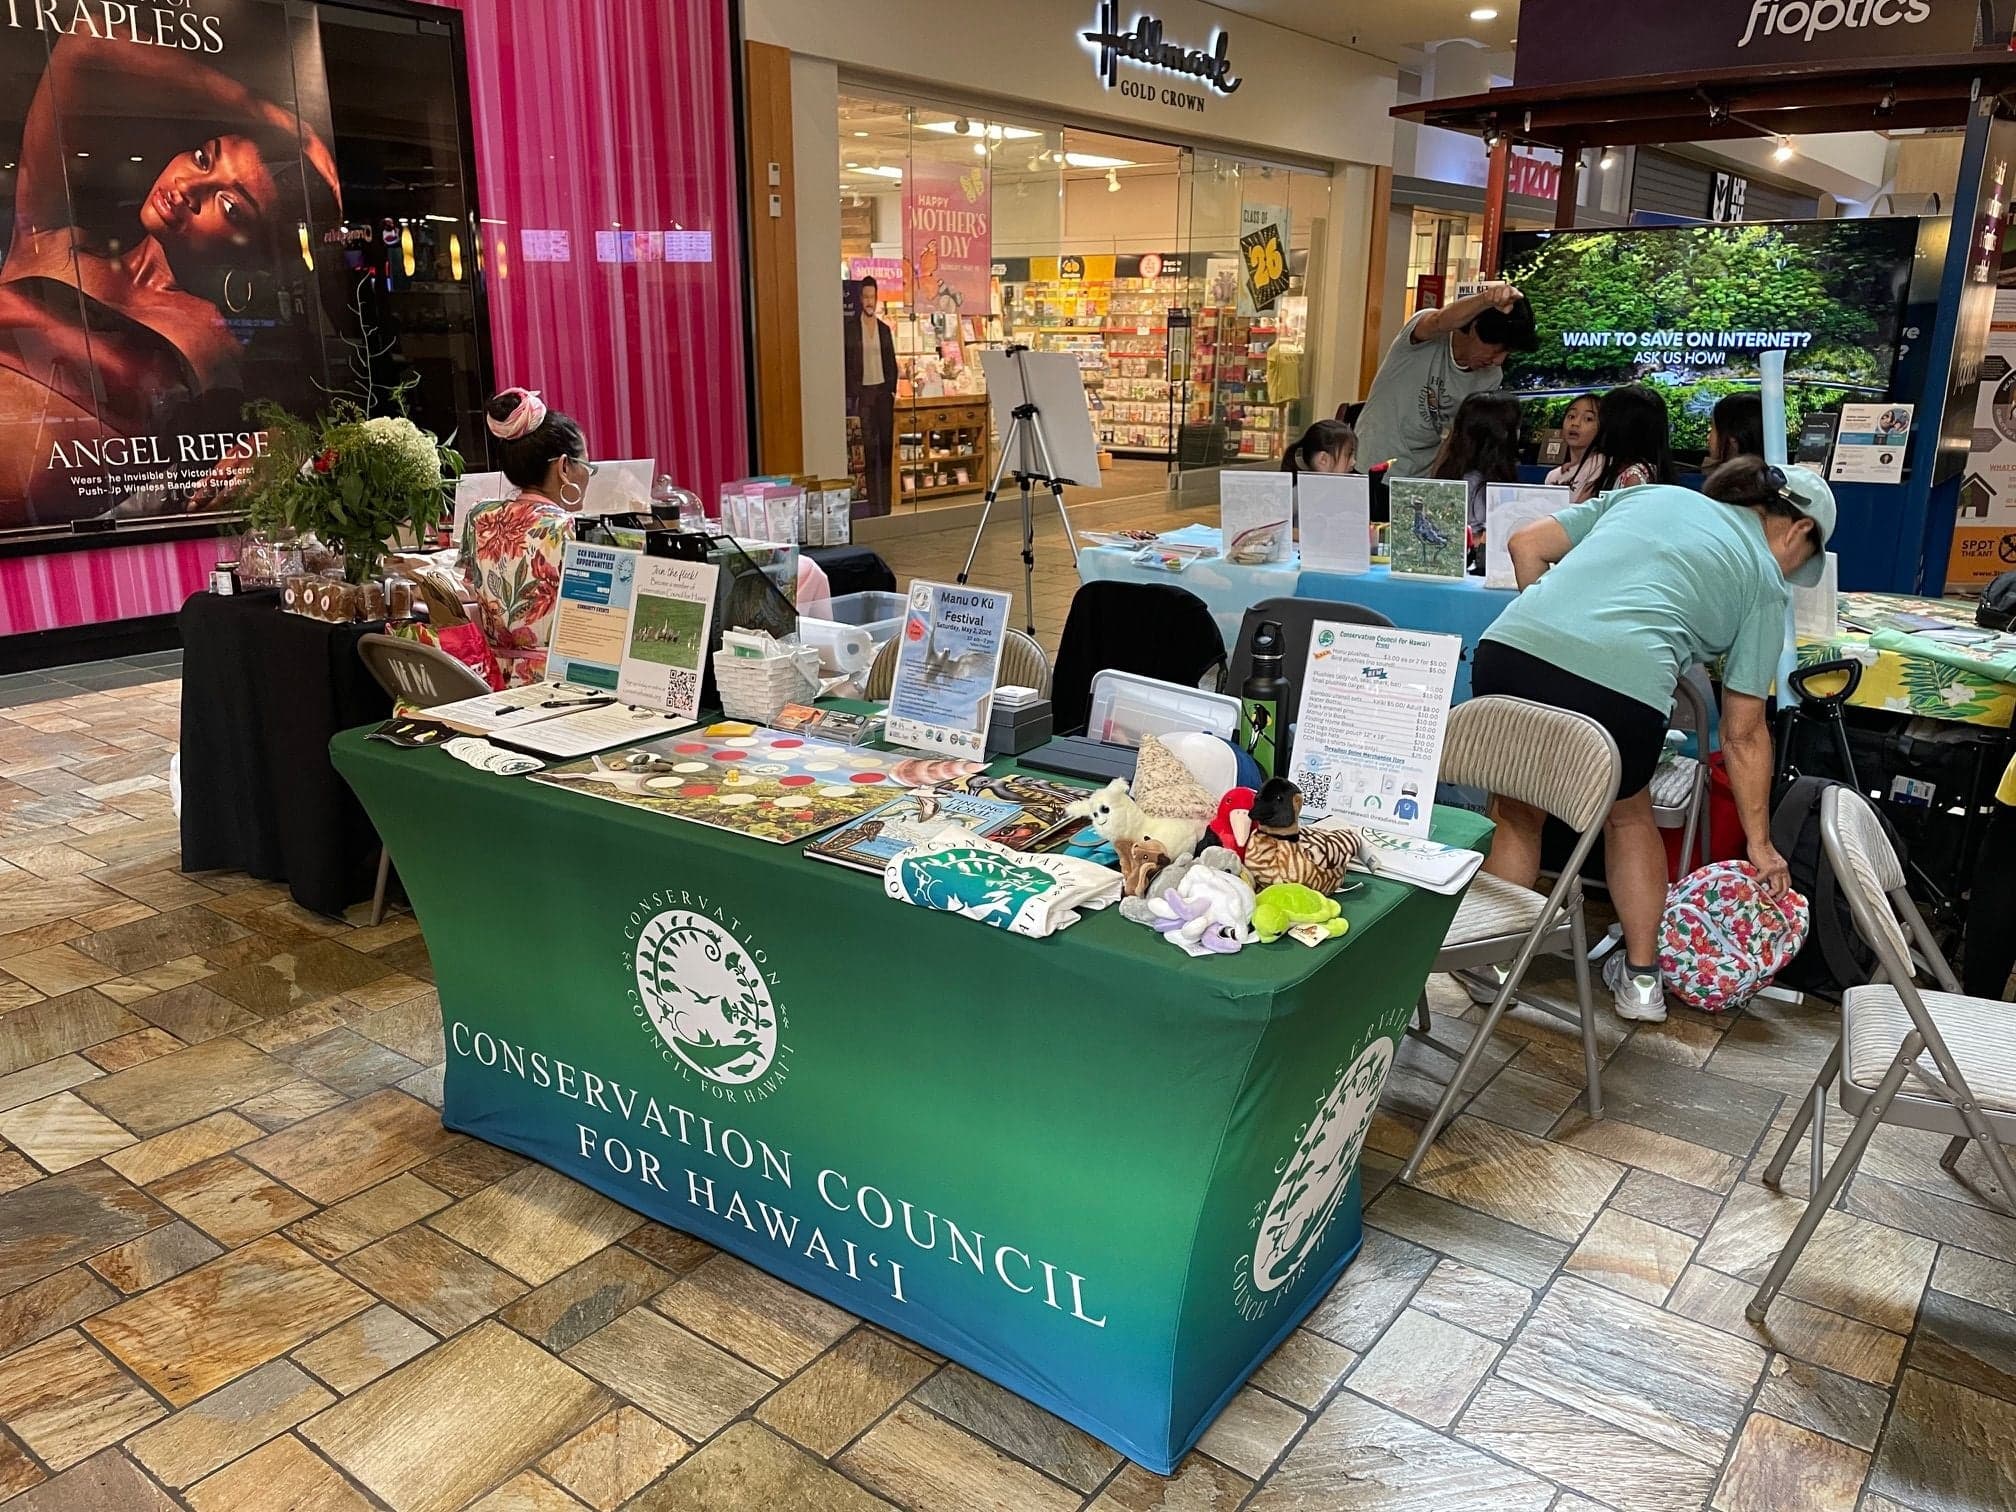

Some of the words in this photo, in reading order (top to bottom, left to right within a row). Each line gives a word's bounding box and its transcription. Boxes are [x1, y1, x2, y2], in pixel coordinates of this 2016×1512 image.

[8, 0, 224, 53] TRAPLESS
[1737, 0, 1930, 47] fioptics
[1082, 0, 1243, 93] Hallmark
[1121, 80, 1156, 101] GOLD
[1161, 90, 1207, 112] CROWN
[918, 195, 949, 209] HAPPY
[909, 208, 987, 238] MOTHER'S
[1243, 209, 1260, 224] CLASS
[1261, 211, 1269, 224] OF
[940, 235, 972, 259] DAY
[1563, 332, 1611, 347] WANT
[1614, 332, 1637, 347] TO
[1640, 332, 1683, 347] SAVE
[1686, 332, 1714, 347] ON
[1718, 332, 1812, 348] INTERNET?
[1633, 352, 1659, 364] ASK
[1662, 352, 1682, 364] US
[1684, 352, 1726, 365] HOW!
[47, 436, 170, 469] ANGEL
[176, 431, 272, 462] REESE
[71, 476, 102, 485] Wears
[124, 471, 164, 482] Invisible
[166, 471, 178, 481] by
[180, 467, 224, 479] Victoria's
[226, 466, 255, 475] Secret
[124, 483, 165, 494] Wireless
[168, 480, 208, 490] Bandeau
[1961, 540, 1996, 551] SPOT
[588, 550, 616, 561] VOLUNTEER
[576, 558, 614, 569] OPPORTUNITIES
[667, 567, 678, 577] the
[941, 592, 969, 606] Manu
[970, 596, 979, 607] O
[945, 610, 984, 627] Festival
[936, 622, 961, 632] Saturday,
[961, 626, 974, 635] May
[1340, 631, 1376, 641] Conservation
[1376, 635, 1397, 643] Council
[1342, 657, 1365, 665] plushies
[1305, 715, 1325, 723] Finding
[1416, 718, 1437, 727] $10.00
[1418, 712, 1439, 720] $10.00
[1415, 725, 1436, 733] $10.00
[945, 803, 995, 818] HOME
[951, 798, 1004, 814] FINDING
[624, 890, 781, 985] CONSERVATION
[627, 989, 691, 1082] COUNCIL
[701, 1080, 737, 1103] FOR
[578, 1124, 670, 1193] FOR
[451, 1022, 793, 1190] CONSERVATION
[817, 1168, 1107, 1328] COUNCIL
